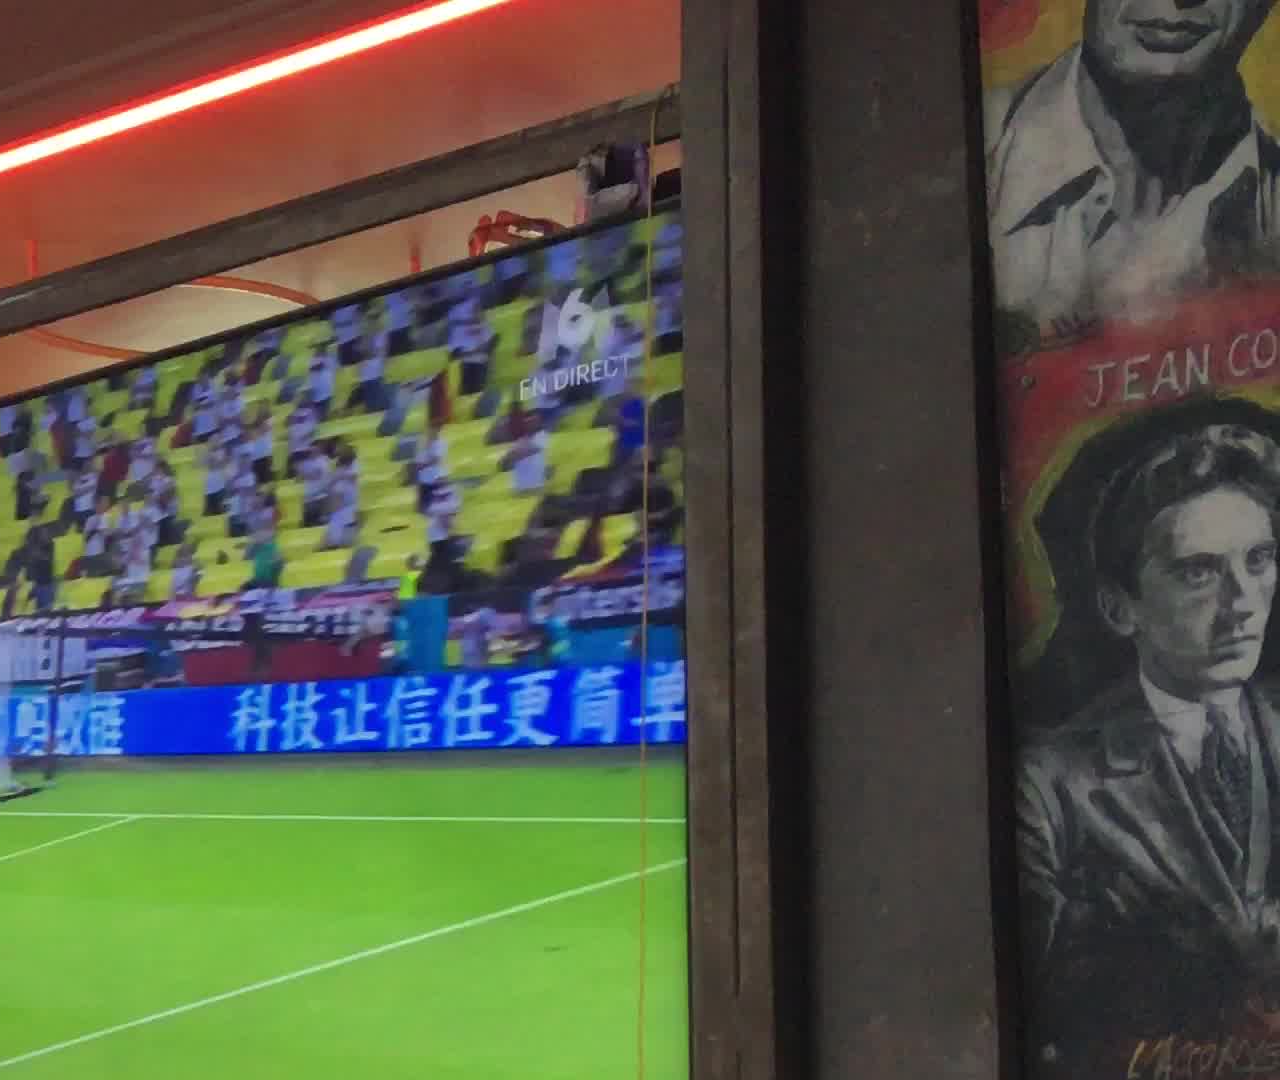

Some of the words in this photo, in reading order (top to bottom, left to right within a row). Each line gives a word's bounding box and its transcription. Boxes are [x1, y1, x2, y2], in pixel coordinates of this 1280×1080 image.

[519, 378, 547, 401] EN
[553, 354, 631, 391] DIRECT
[1087, 343, 1211, 408] JEAN
[231, 660, 686, 753] 科技让信任更简单
